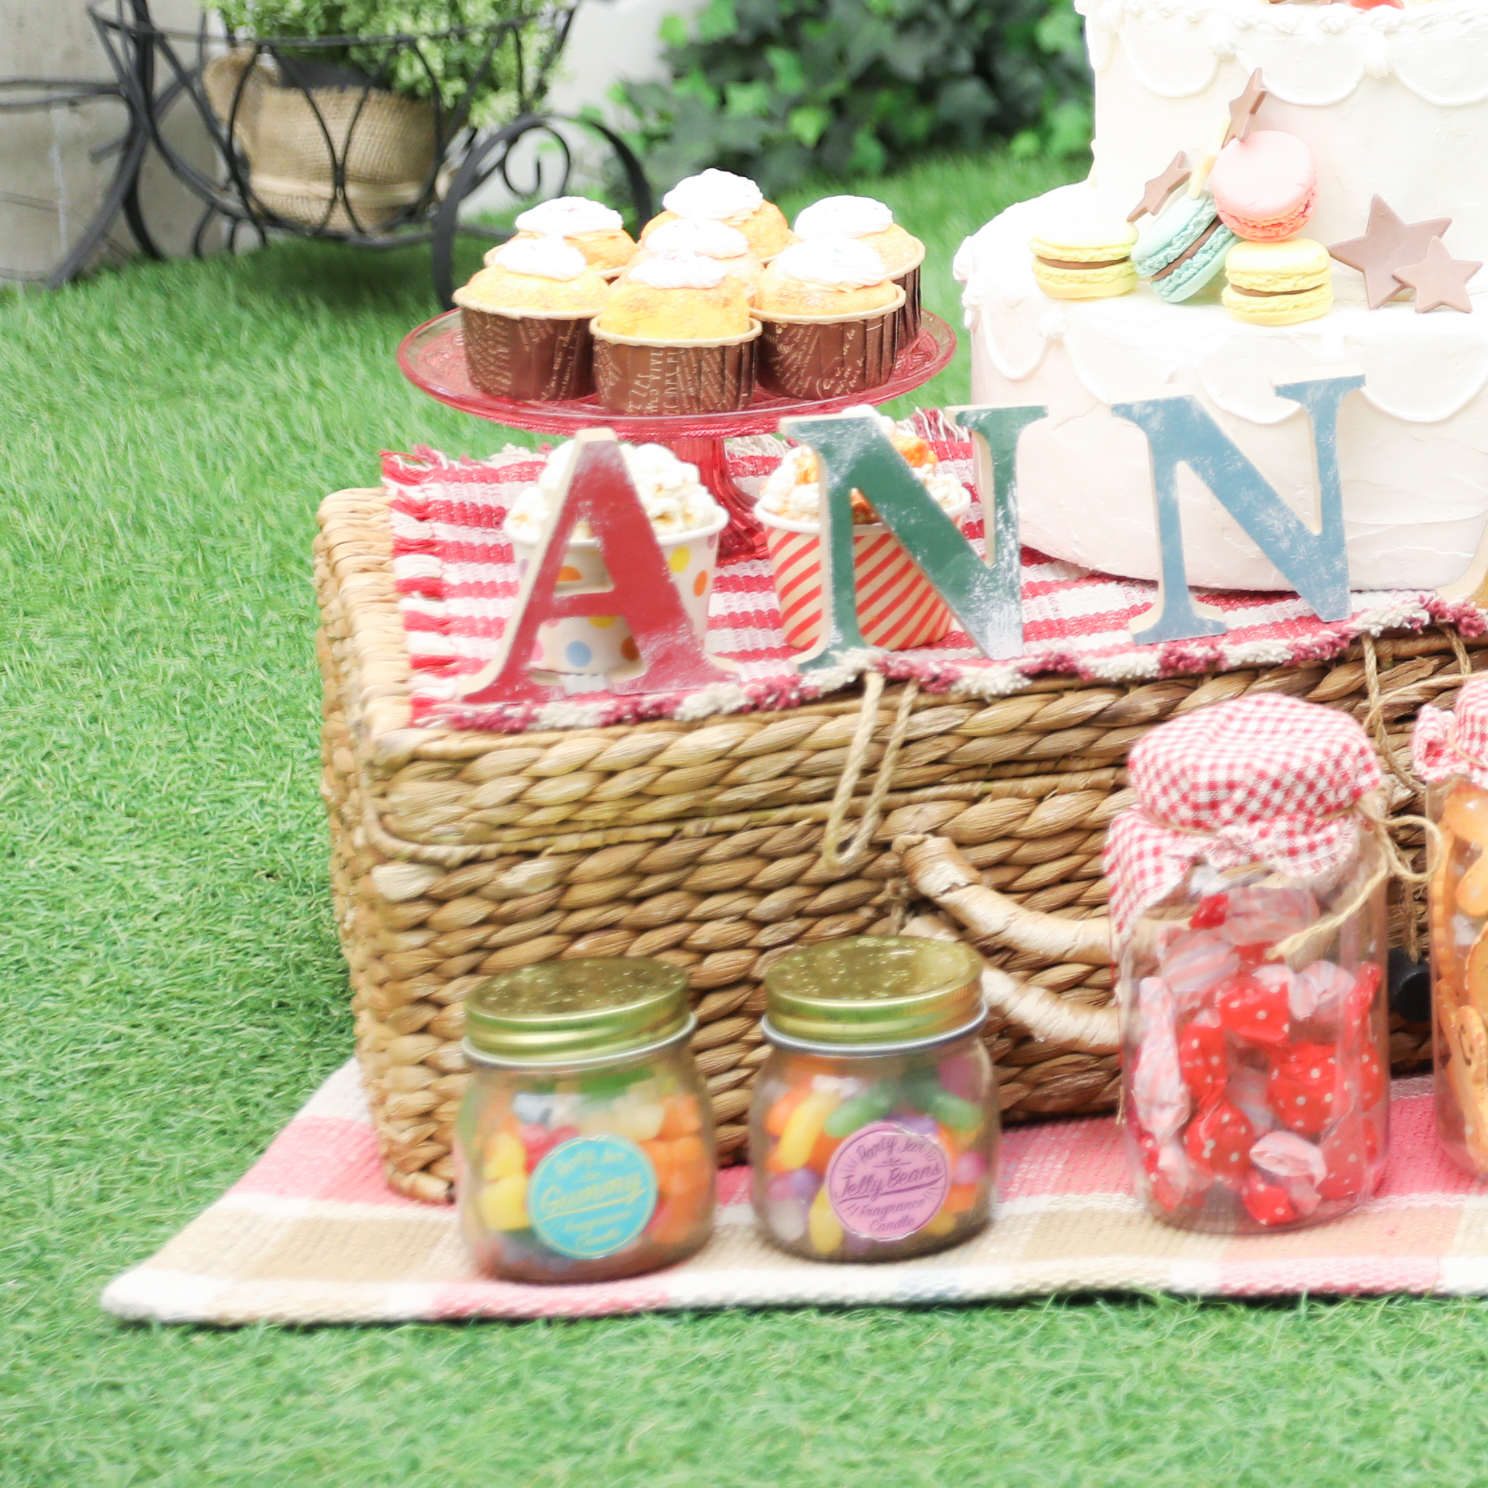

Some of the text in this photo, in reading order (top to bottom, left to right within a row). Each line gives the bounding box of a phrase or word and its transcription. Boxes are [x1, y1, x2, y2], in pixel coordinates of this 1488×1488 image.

[856, 1136, 898, 1164] Party
[835, 1161, 943, 1203] Jelly Beans
[859, 1197, 926, 1221] Fragrance
[868, 1214, 915, 1232] Candle
